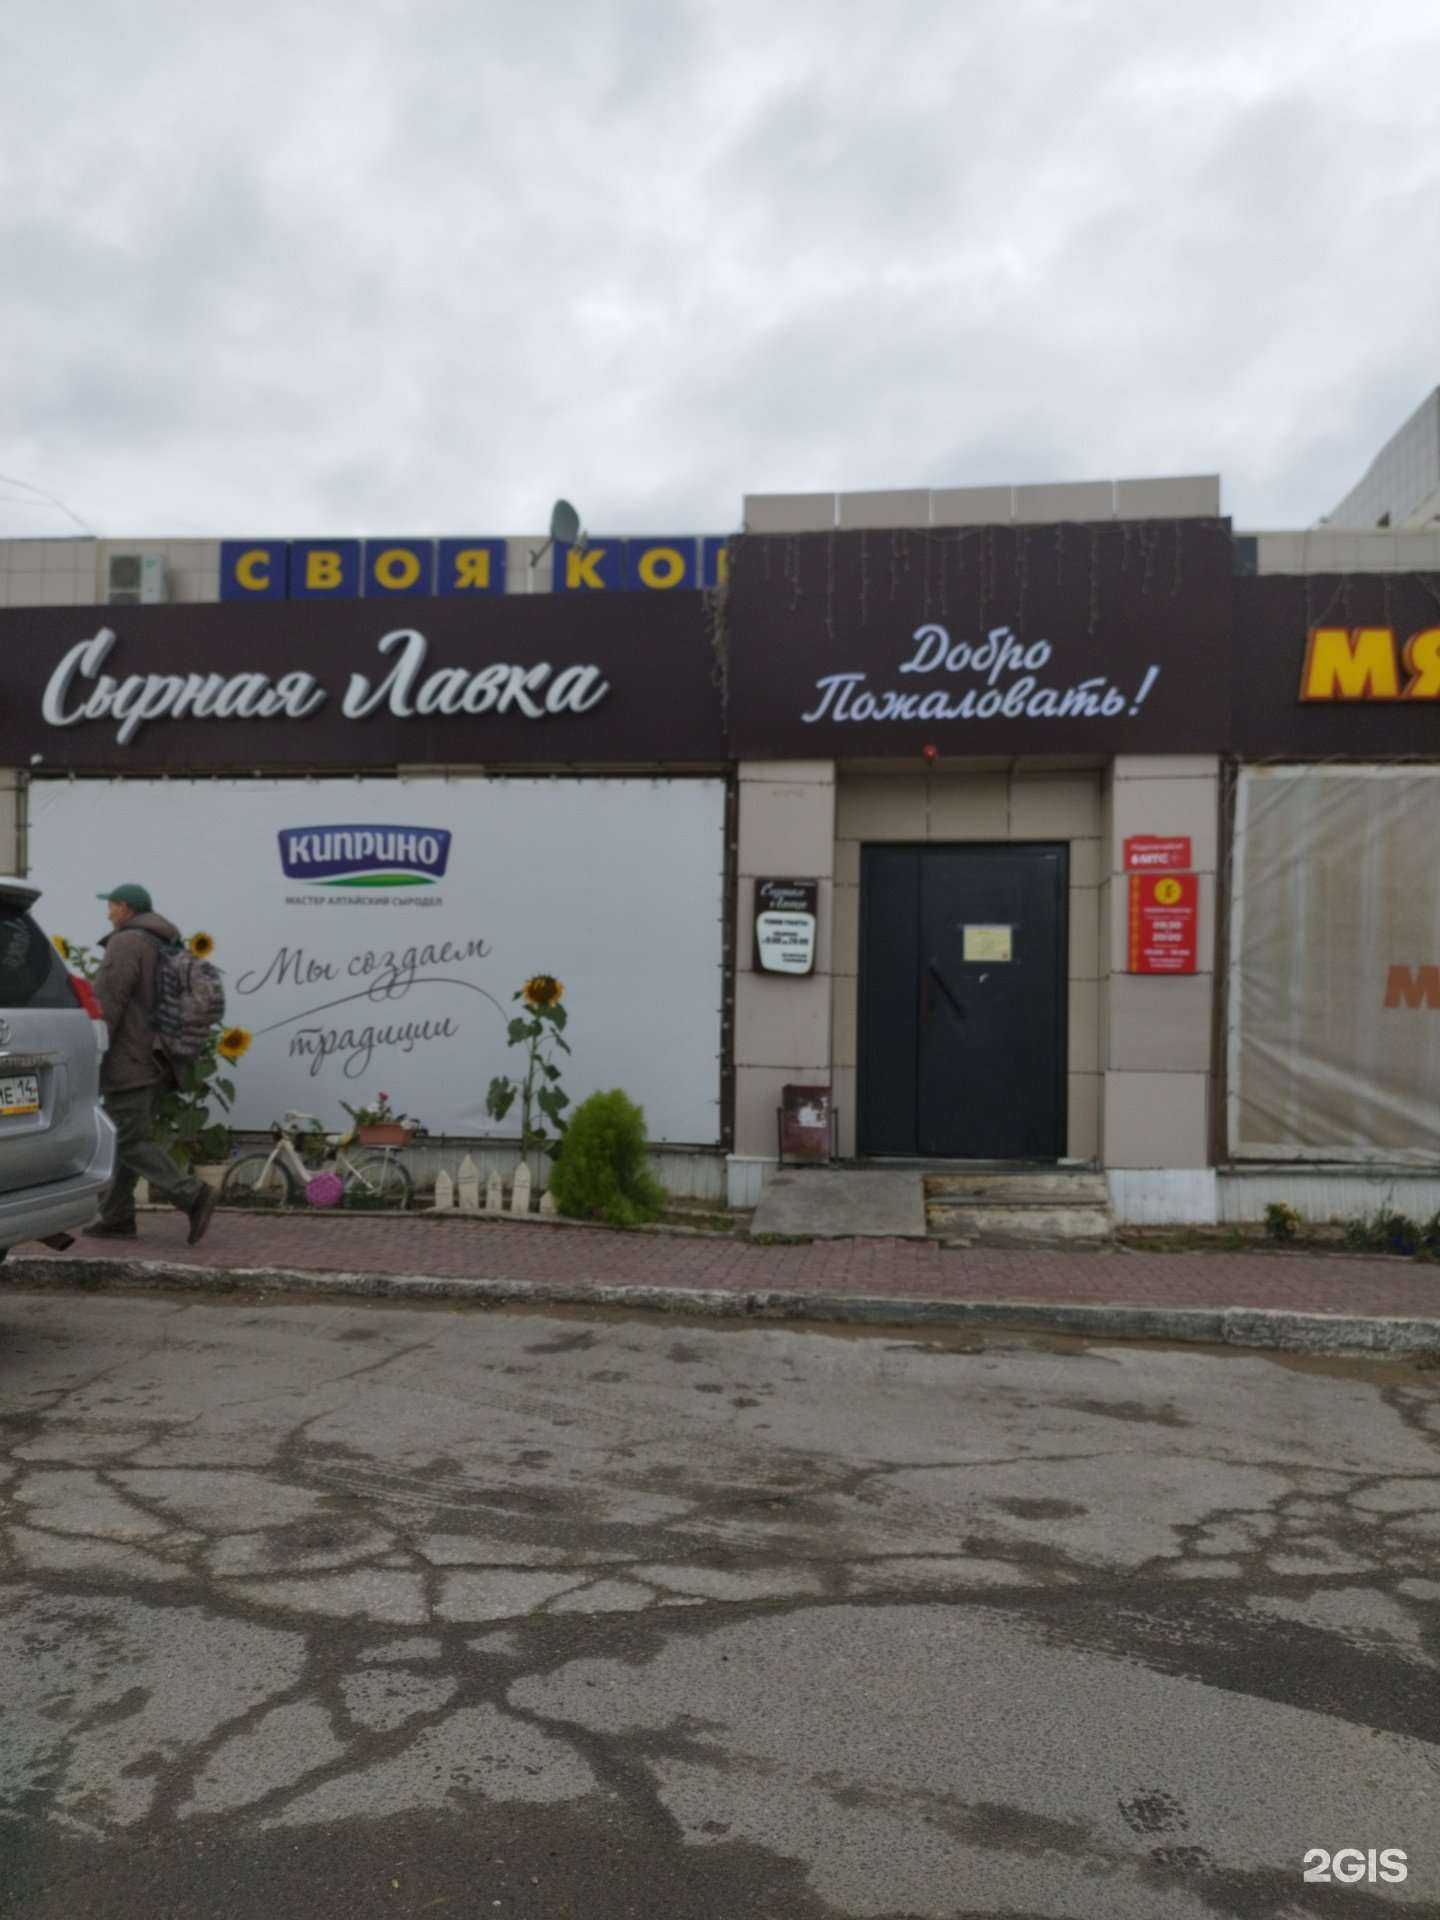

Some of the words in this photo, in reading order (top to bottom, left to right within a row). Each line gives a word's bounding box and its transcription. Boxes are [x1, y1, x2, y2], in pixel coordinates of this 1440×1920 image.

[235, 549, 490, 590] СВОЯ
[566, 547, 728, 590] КО
[899, 623, 1053, 686] Добро
[41, 627, 327, 746] Сырная
[341, 629, 610, 719] Лавка
[801, 665, 1161, 723] Пожаловать!
[236, 946, 338, 996] Мы
[347, 938, 491, 1002] создаем
[288, 1017, 458, 1079] традиции
